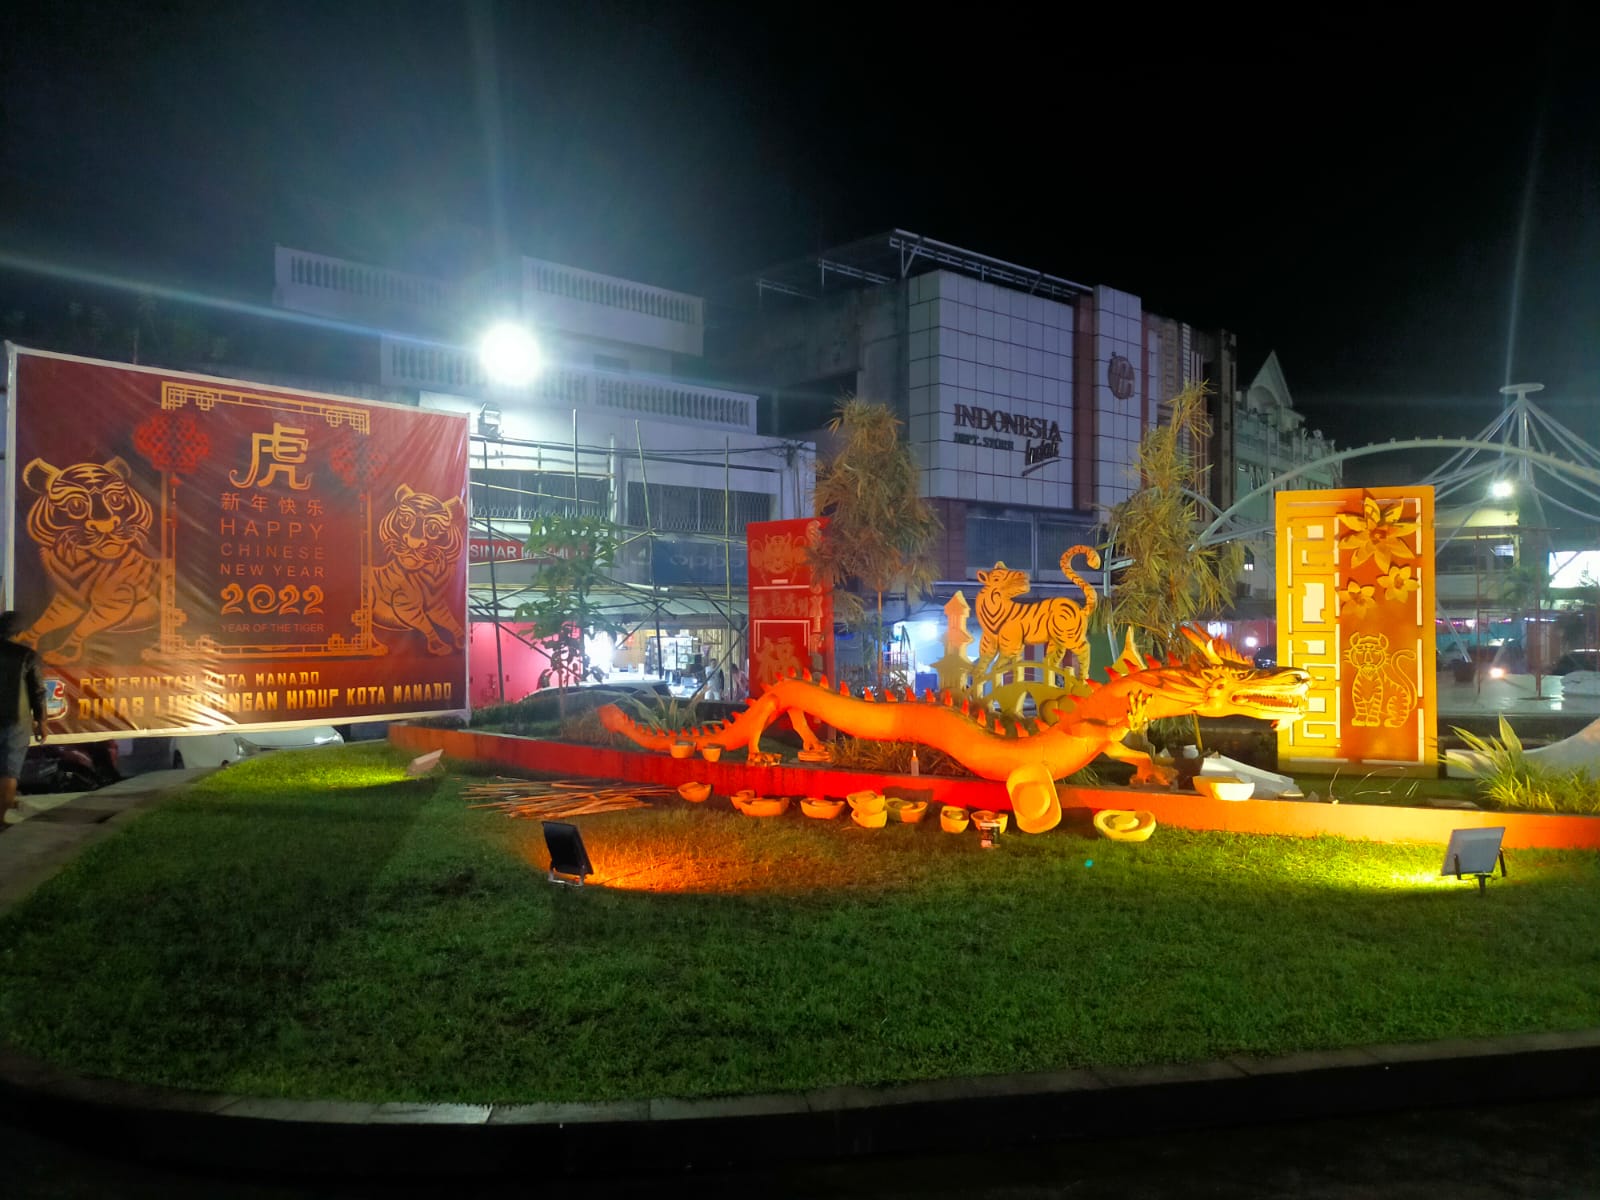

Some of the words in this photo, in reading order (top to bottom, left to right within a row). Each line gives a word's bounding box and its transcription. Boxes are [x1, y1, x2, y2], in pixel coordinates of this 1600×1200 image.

[953, 403, 1063, 442] INDONESIA
[229, 422, 314, 490] 虎
[221, 492, 324, 516] 新年快乐
[220, 518, 323, 541] HAPPY
[221, 542, 324, 560] CHINESE
[470, 544, 517, 559] SINAR
[220, 563, 264, 576] NEW
[273, 565, 325, 578] YEAR
[220, 583, 325, 615] 2022
[221, 623, 250, 633] YEAR
[252, 623, 268, 633] OF
[271, 623, 291, 633] THE
[293, 623, 325, 633] TIGER
[256, 671, 320, 687] MANADO
[77, 696, 145, 721] DINAS
[154, 690, 278, 717] LINGUNGAN
[286, 688, 339, 710] HIDUP
[346, 685, 386, 706] KOTA
[393, 682, 452, 703] MANADO
